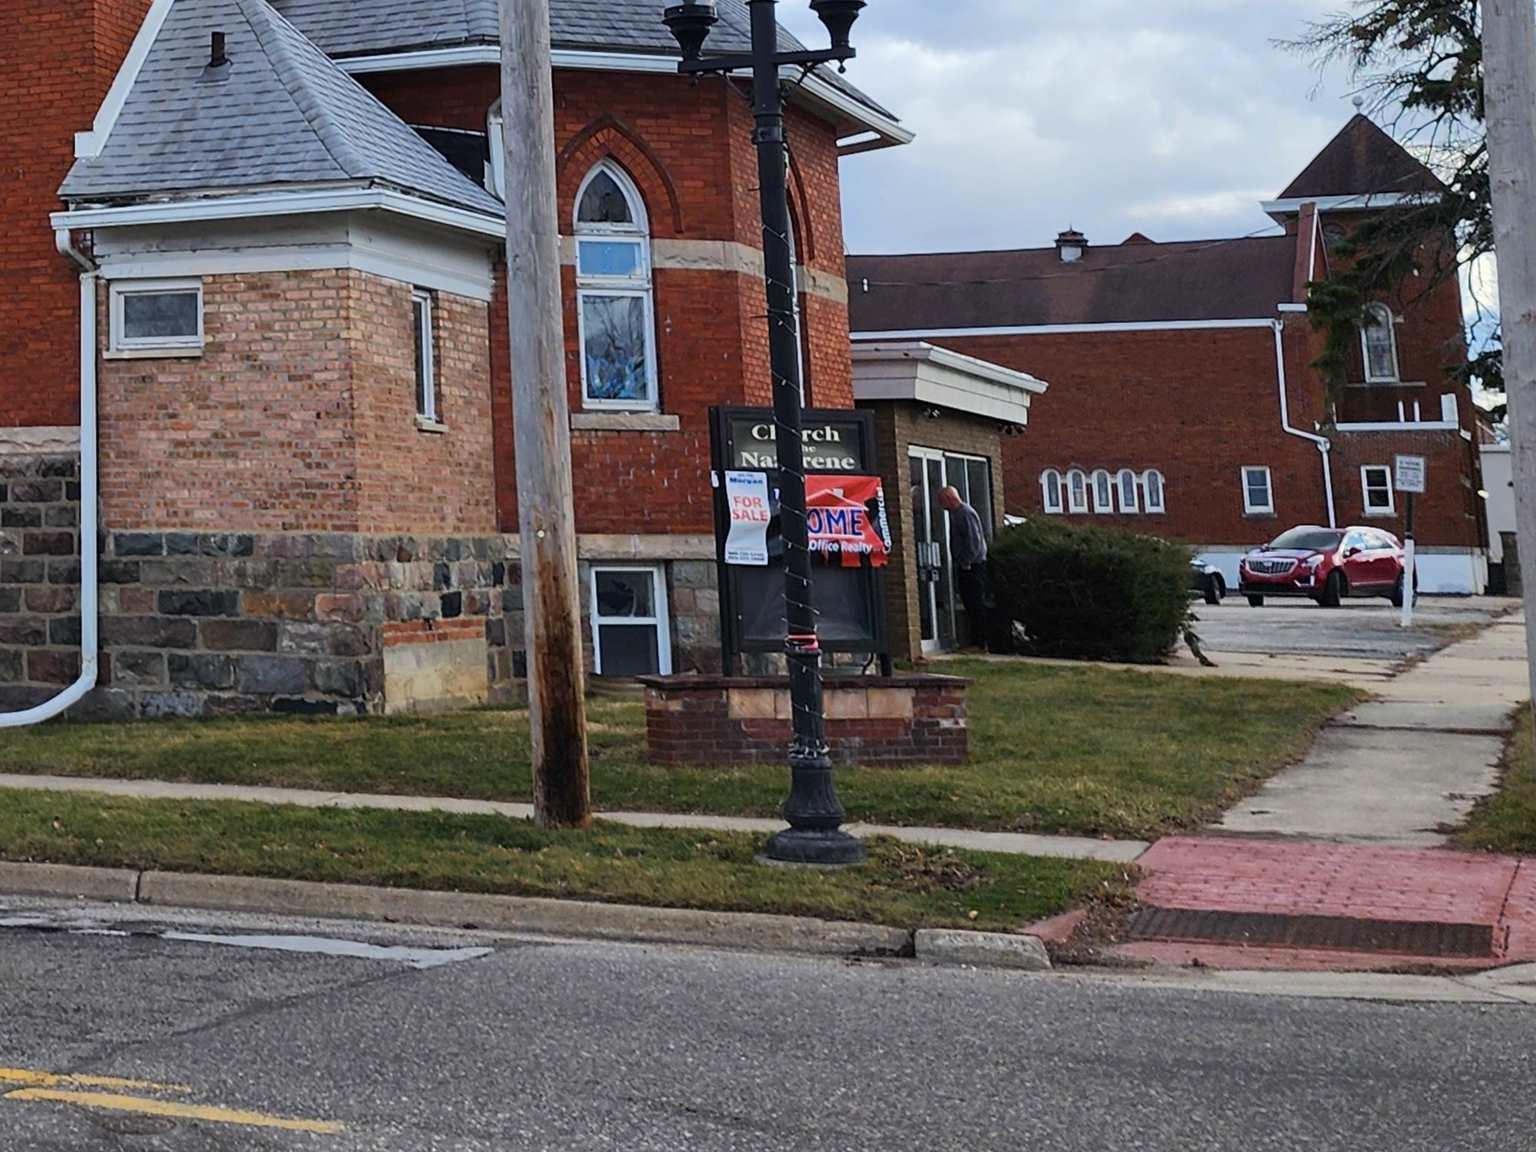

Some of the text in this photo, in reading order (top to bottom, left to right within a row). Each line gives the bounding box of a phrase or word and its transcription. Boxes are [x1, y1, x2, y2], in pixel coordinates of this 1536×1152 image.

[751, 424, 841, 442] Crch
[740, 451, 855, 470] Narene
[733, 496, 763, 508] FOR
[732, 509, 769, 522] SALE
[806, 508, 863, 536] OME
[809, 539, 873, 554] Office Realty
